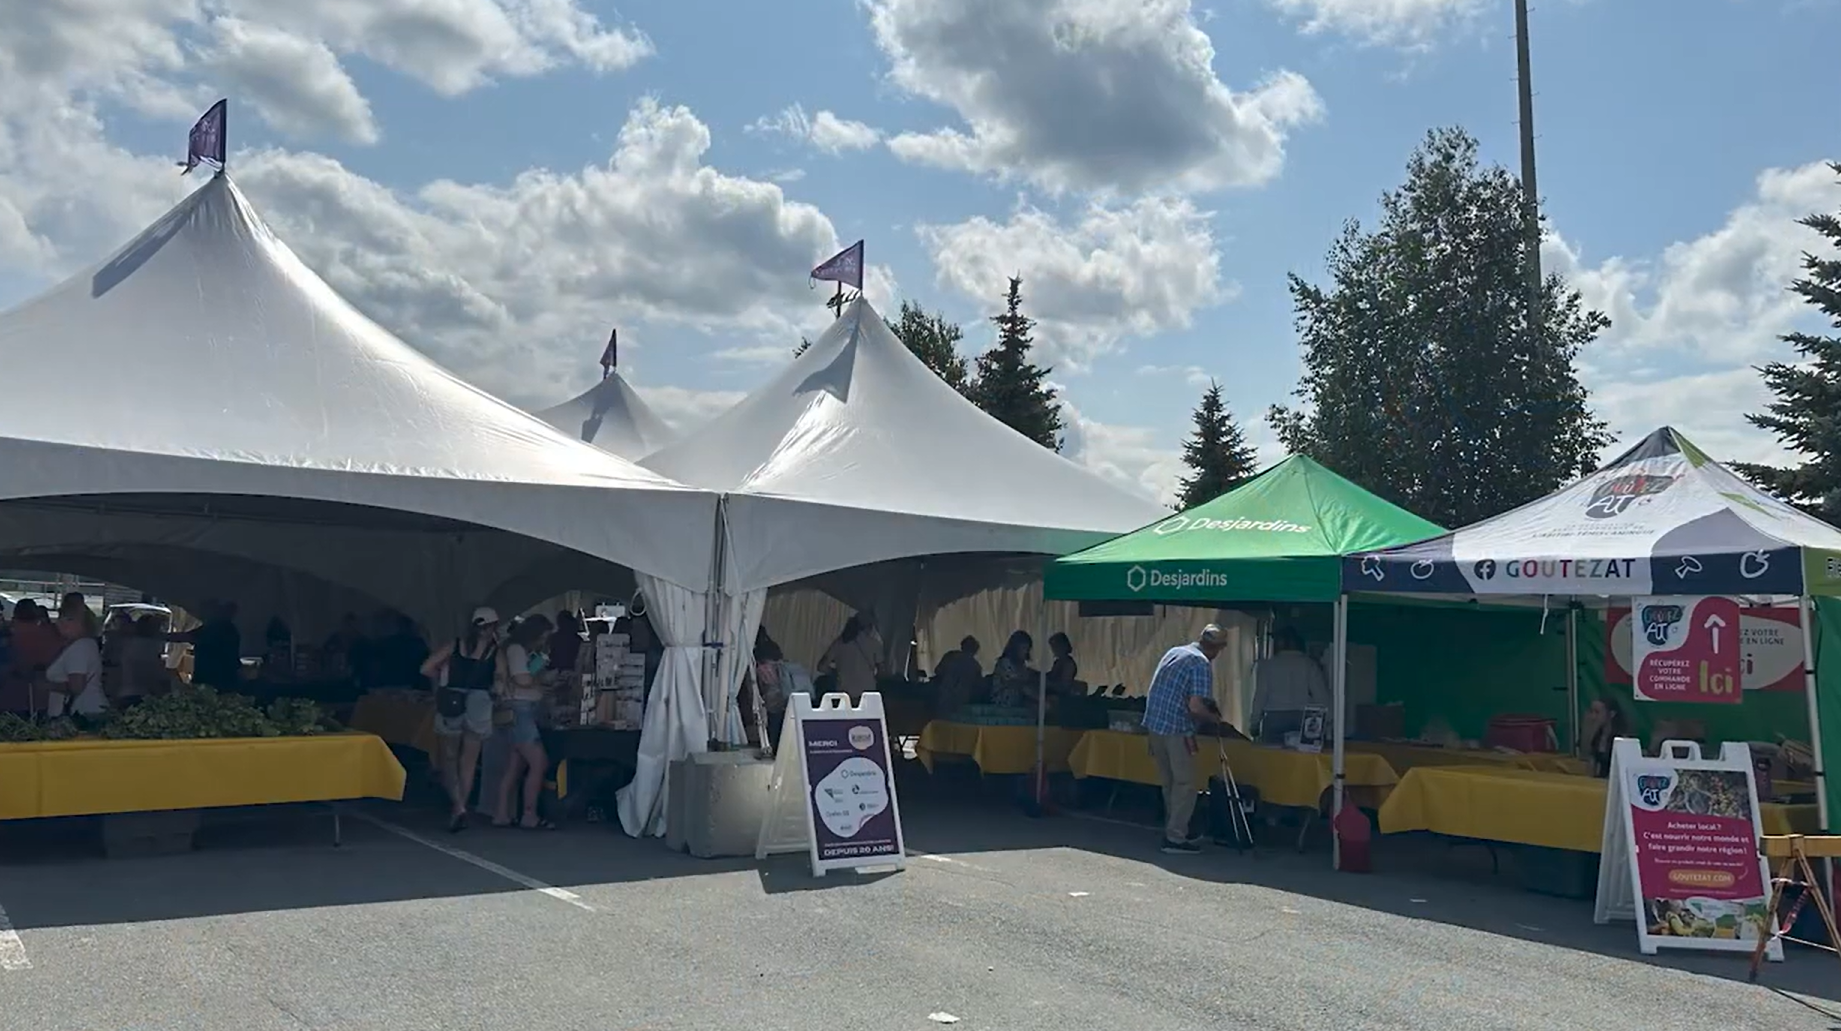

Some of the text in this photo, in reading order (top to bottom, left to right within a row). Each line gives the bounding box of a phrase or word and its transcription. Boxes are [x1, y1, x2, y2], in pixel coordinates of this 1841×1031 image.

[1187, 516, 1312, 534] Desjardins
[1506, 558, 1636, 579] GOUTEZAT
[1150, 569, 1228, 590] Desjardins
[1750, 628, 1779, 637] VOTRE
[1747, 637, 1758, 645] EN
[1760, 637, 1785, 646] LIGNE
[1649, 658, 1690, 667] RÉCUPÉREZ
[1657, 667, 1682, 675] VOTRE
[1649, 675, 1691, 683] COMMANDE
[1700, 660, 1734, 695] Ici
[1665, 683, 1686, 691] LIGNE
[1643, 831, 1750, 844] C'est nourrir notre monde et
[823, 847, 859, 857] DEPUIS
[1648, 842, 1666, 851] faire
[1667, 843, 1695, 853] grandir
[1696, 845, 1718, 853] notre
